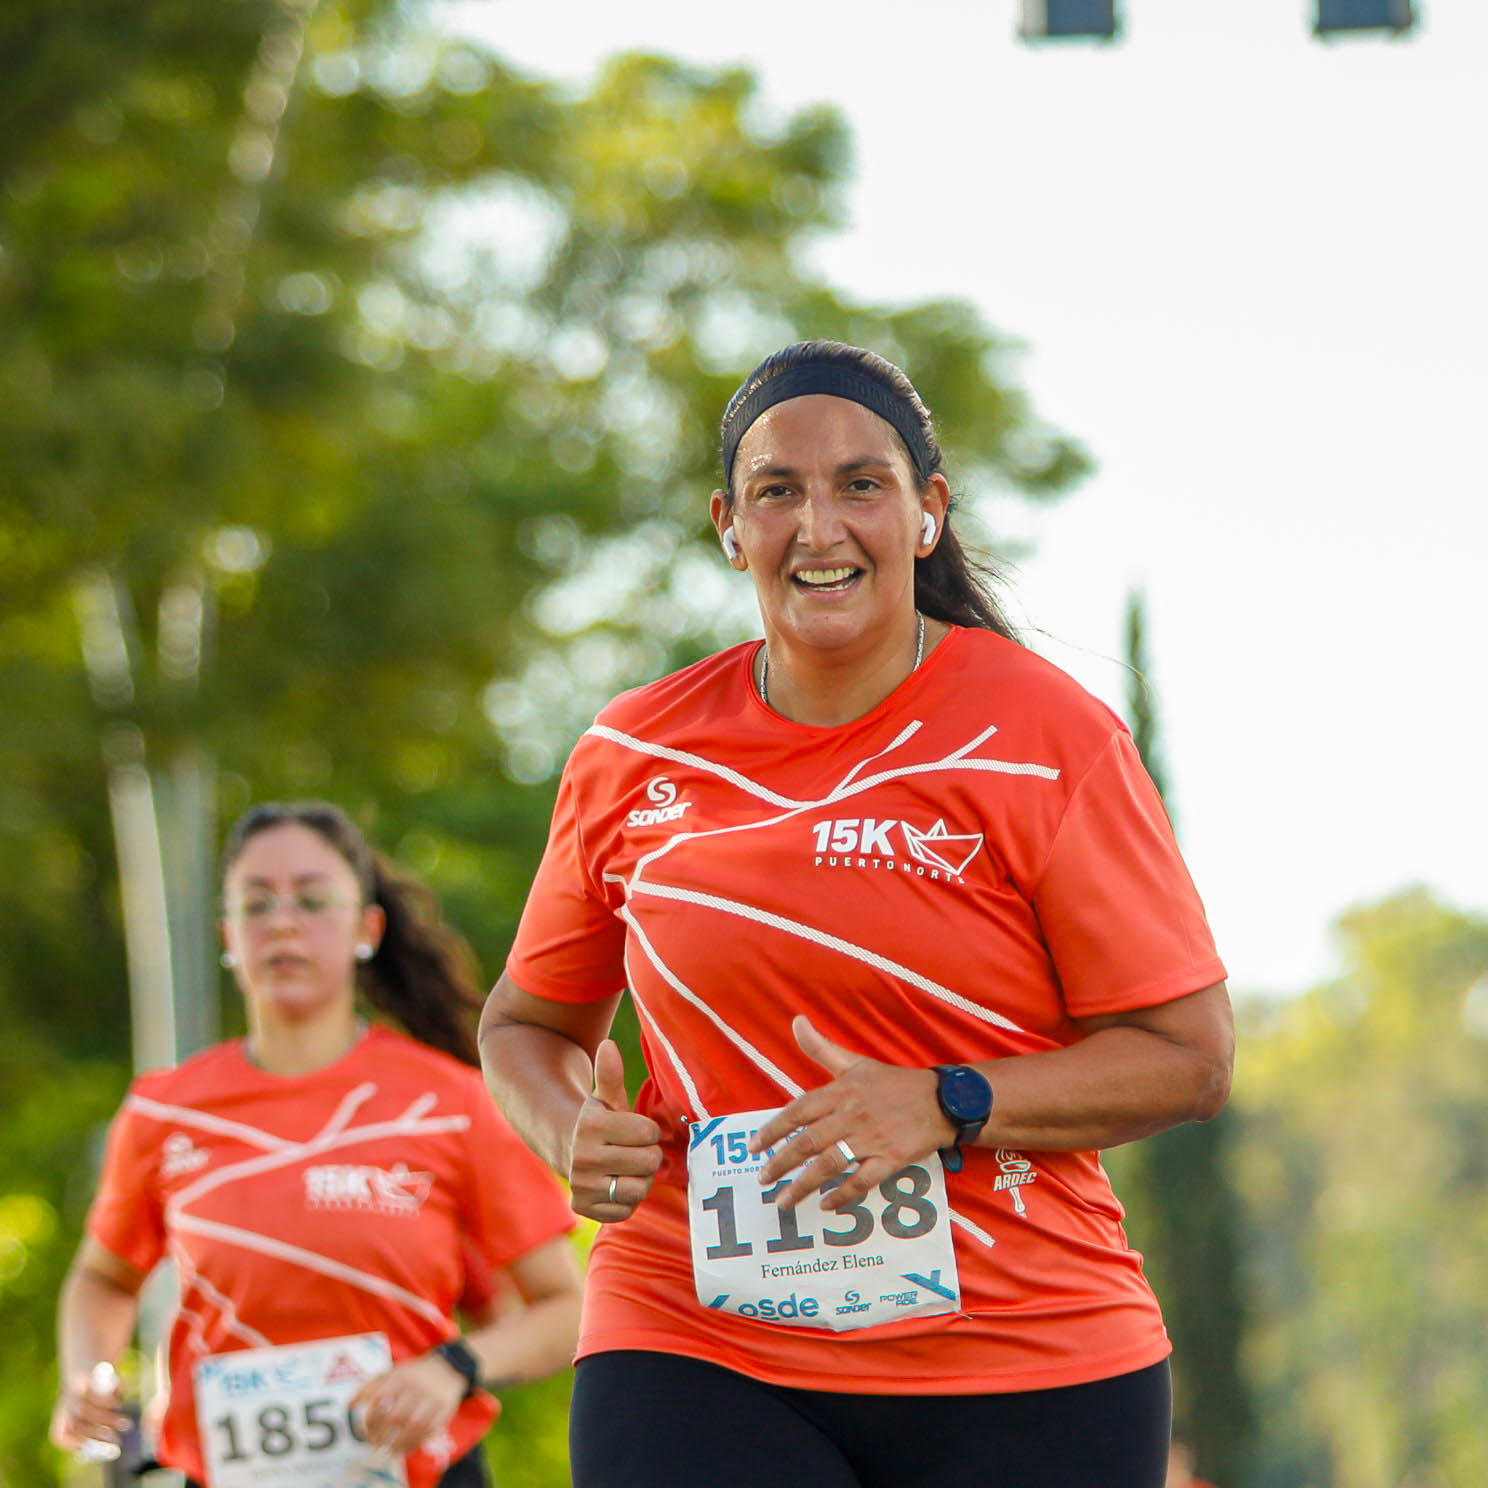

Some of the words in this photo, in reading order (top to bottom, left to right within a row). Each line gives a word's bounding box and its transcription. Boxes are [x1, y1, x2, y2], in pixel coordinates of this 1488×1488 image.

[812, 818, 898, 857] 15K
[815, 857, 896, 870] PUERTO
[993, 1172, 1038, 1192] ARDEC
[702, 1164, 938, 1260] 1138
[761, 1258, 838, 1279] Fernández
[843, 1252, 884, 1270] Elena
[738, 1292, 819, 1320] osde
